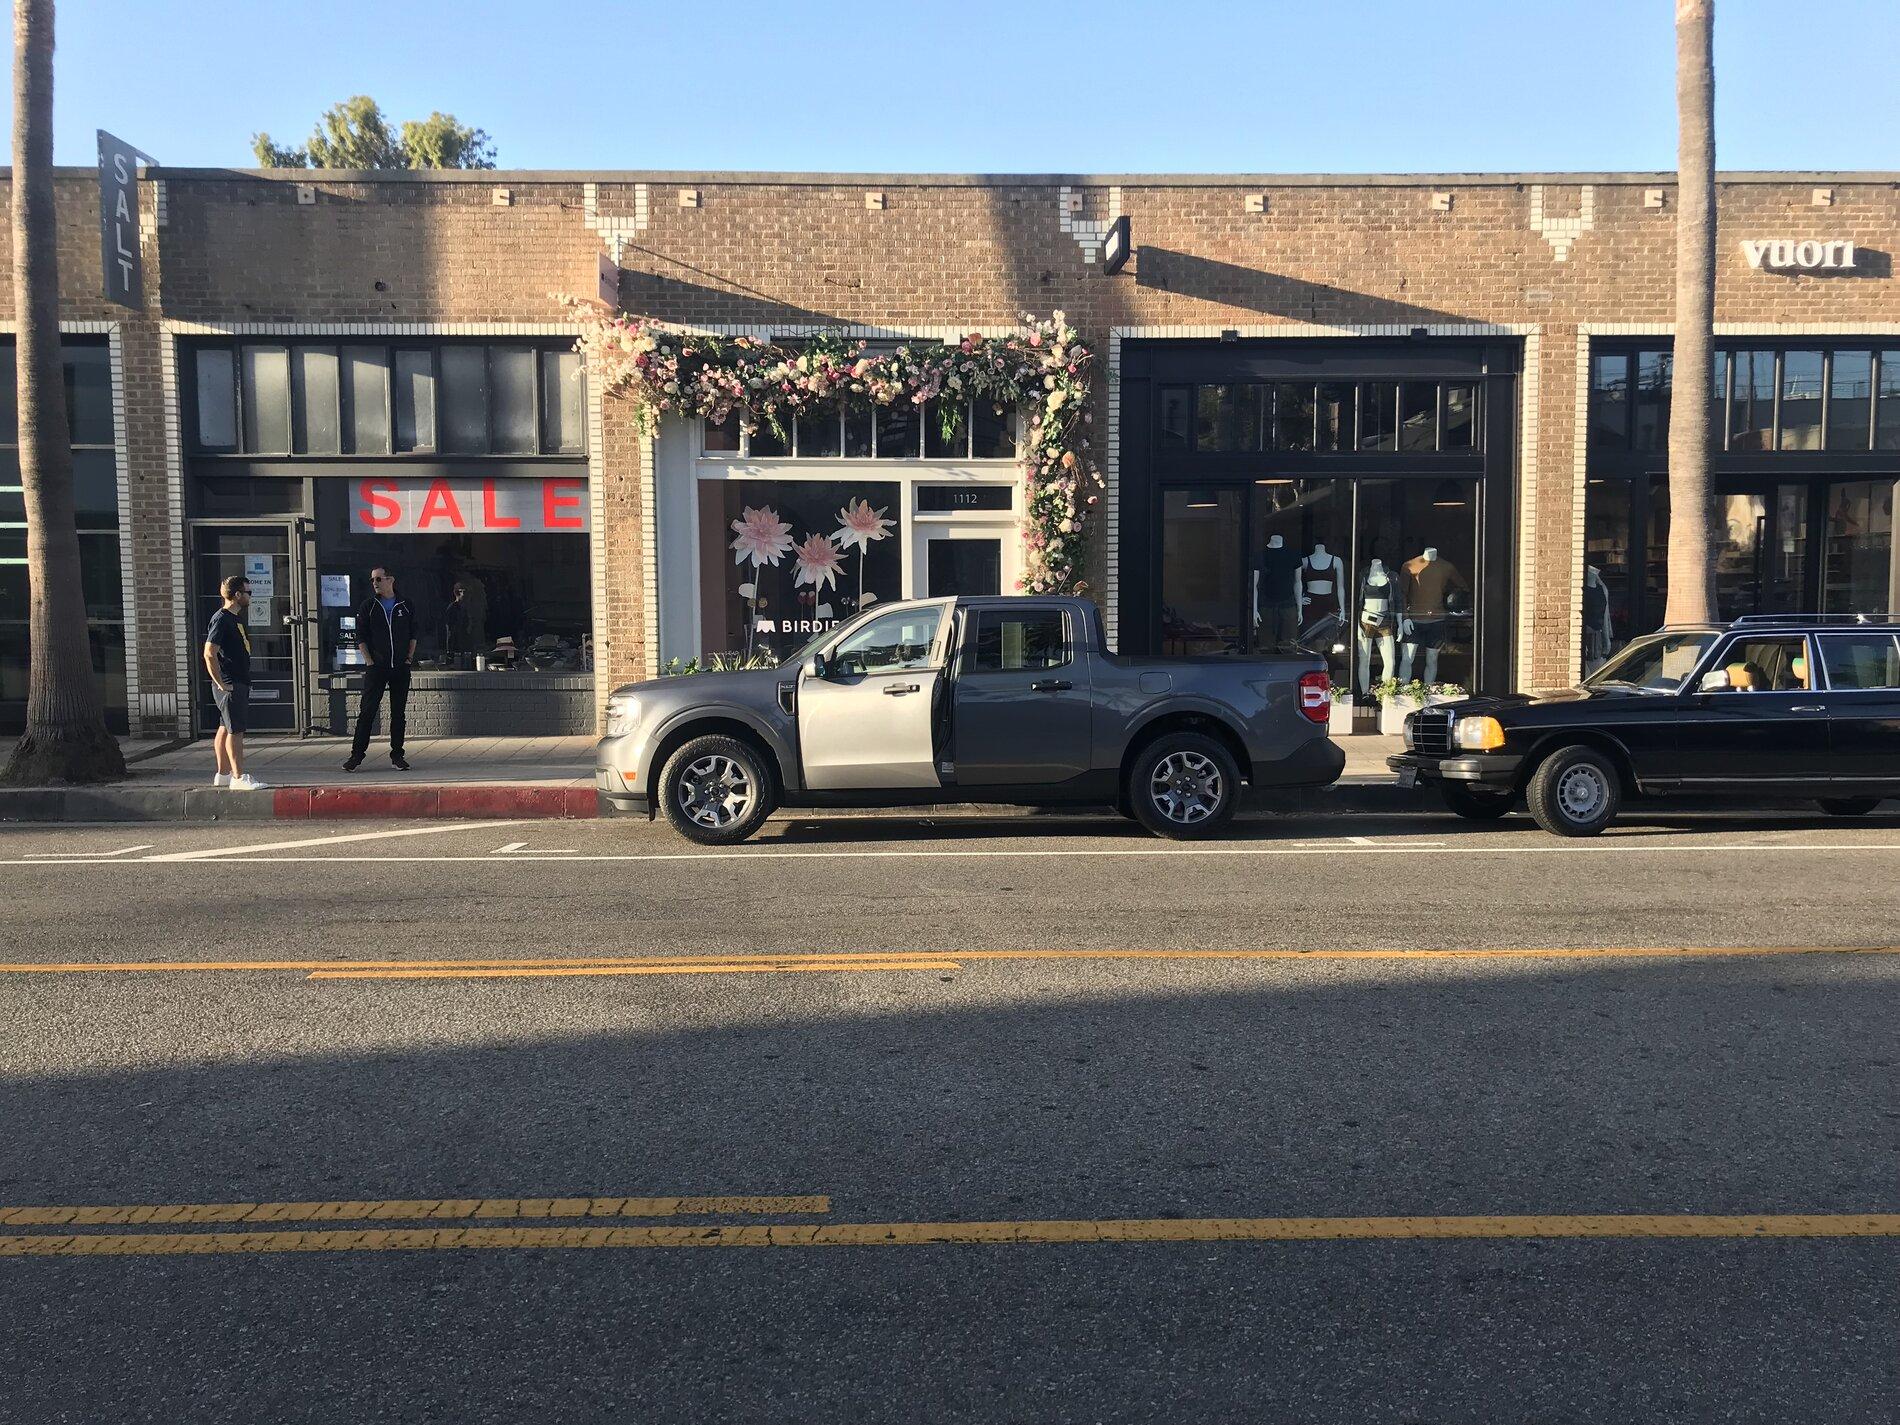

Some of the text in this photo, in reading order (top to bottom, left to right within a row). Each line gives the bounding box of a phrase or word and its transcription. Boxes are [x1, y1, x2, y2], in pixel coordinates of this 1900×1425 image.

[113, 153, 133, 292] SALT
[1739, 239, 1857, 268] vuori
[357, 477, 583, 528] SALE
[953, 493, 977, 503] 1112
